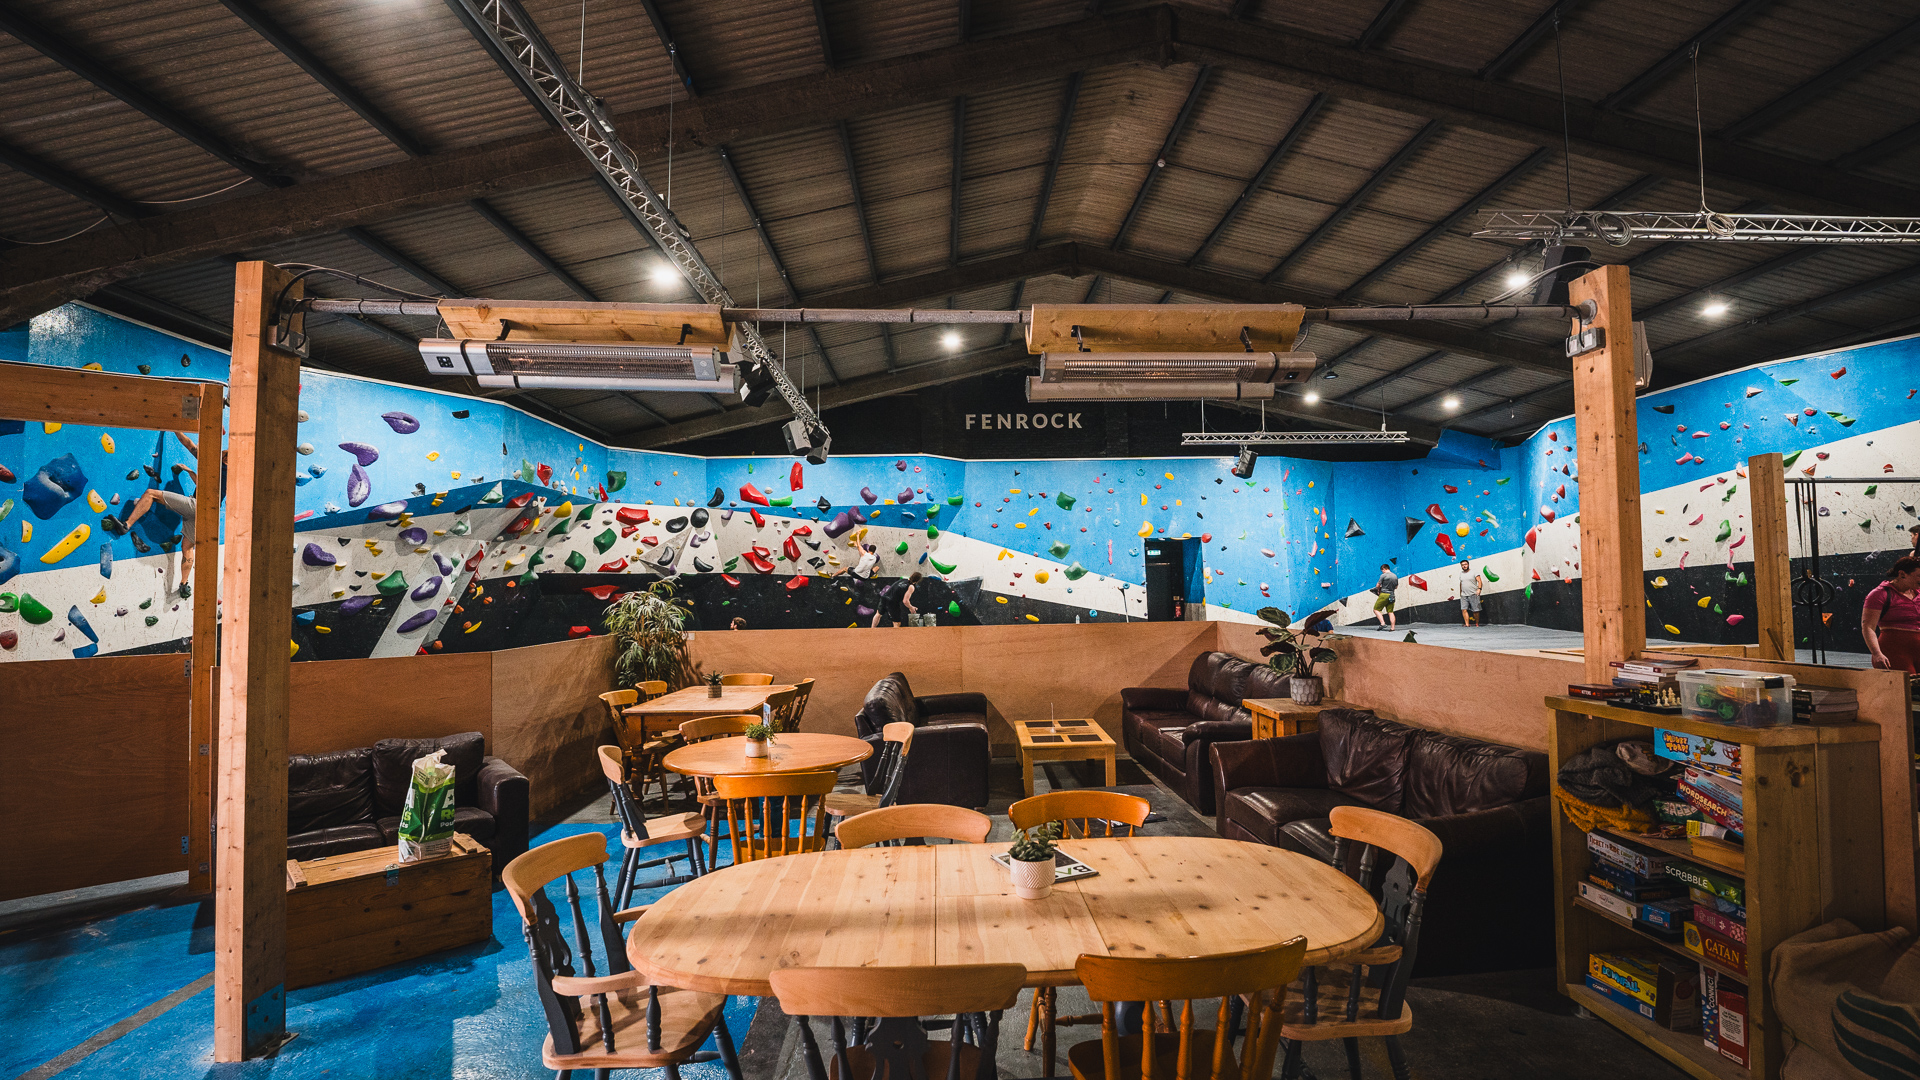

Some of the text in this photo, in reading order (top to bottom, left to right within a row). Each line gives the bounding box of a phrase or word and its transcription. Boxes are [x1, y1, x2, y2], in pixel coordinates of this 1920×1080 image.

[965, 412, 1083, 430] FENROCK
[1679, 782, 1728, 817] WORDSEARCH
[1665, 865, 1709, 889] SCRABBLE
[1705, 938, 1740, 964] CATAN
